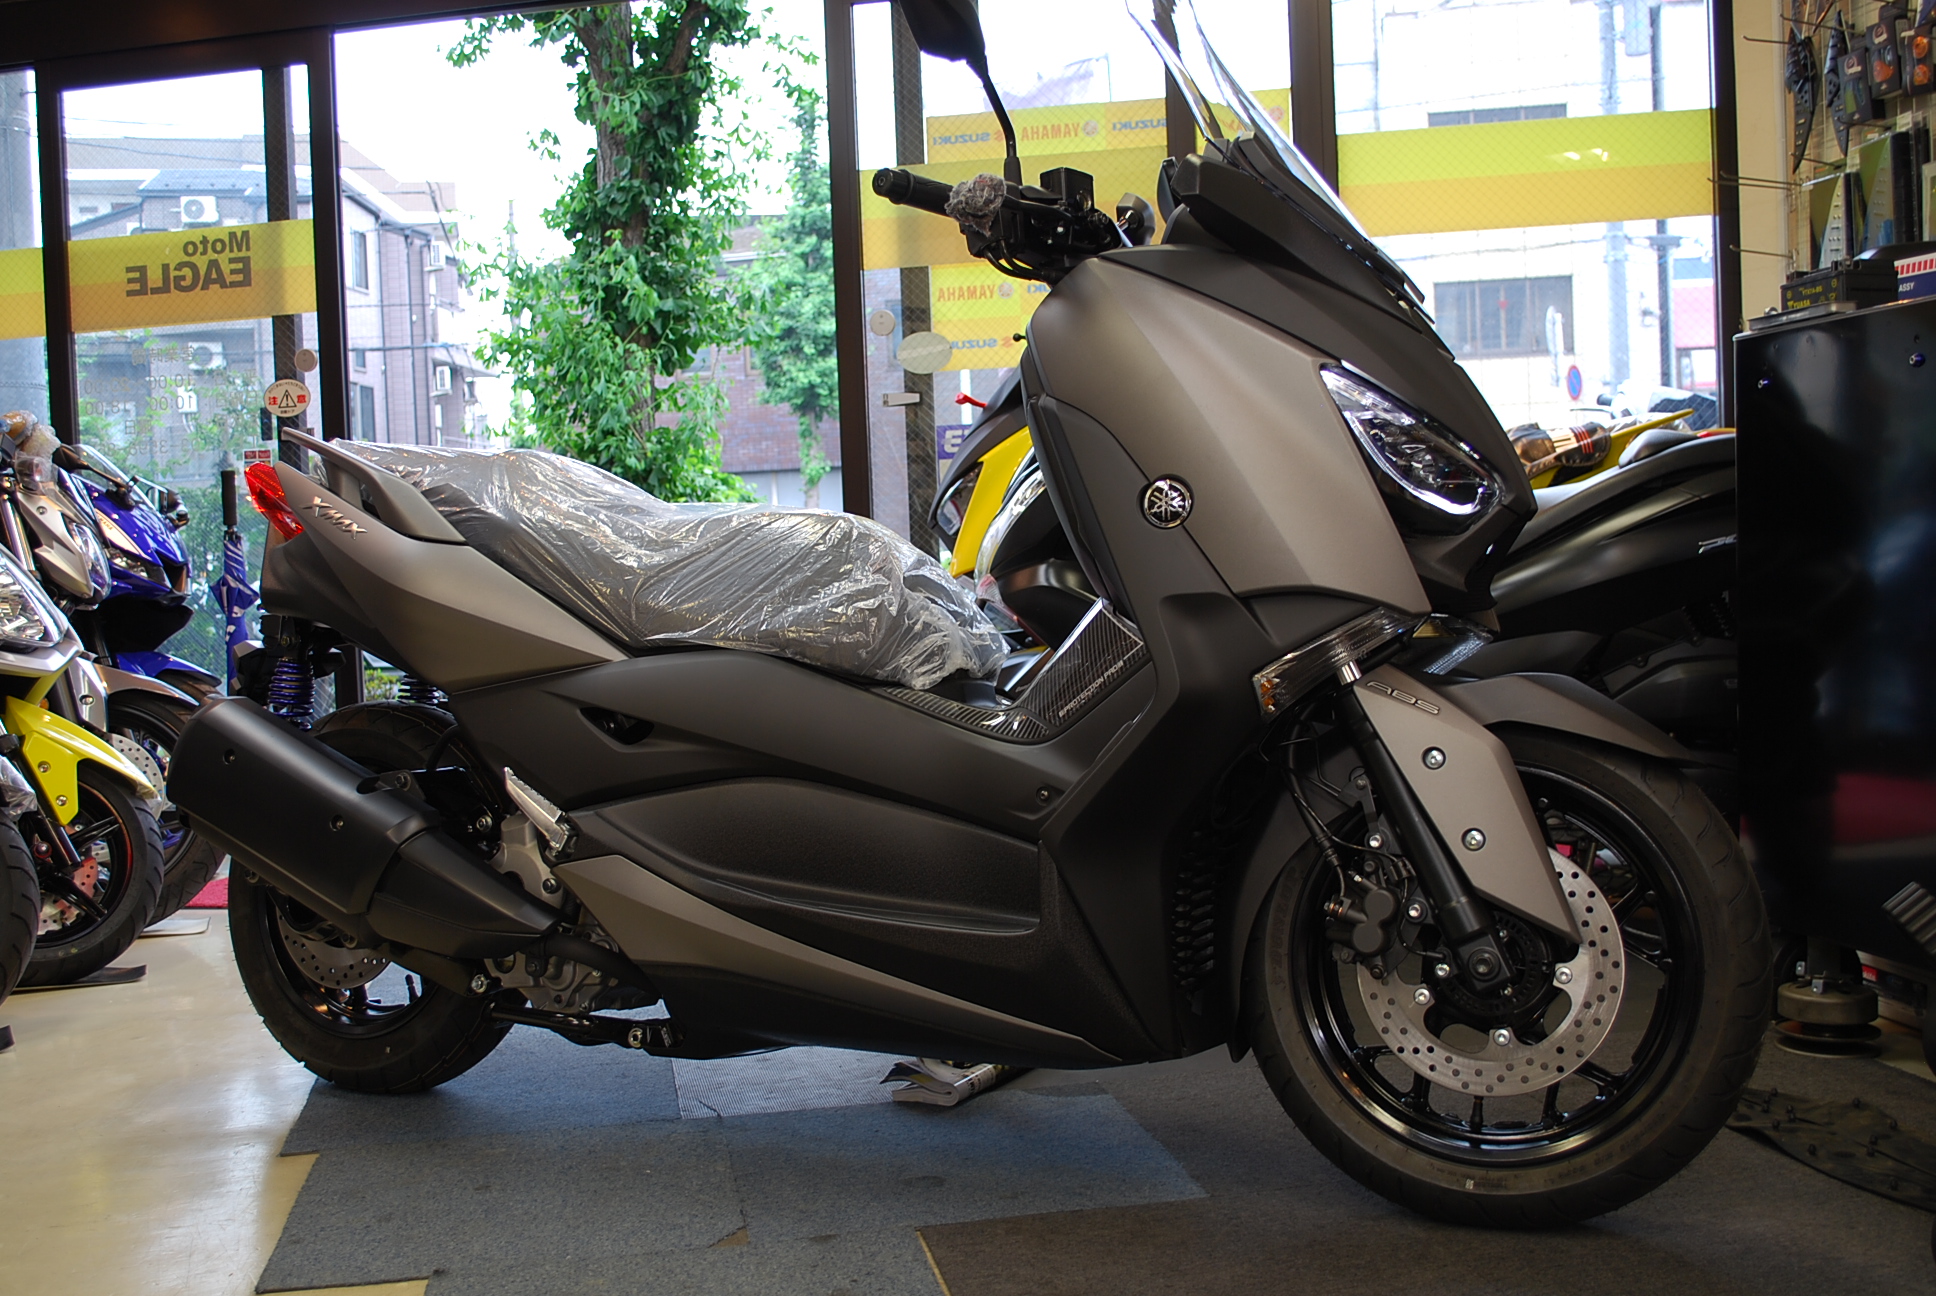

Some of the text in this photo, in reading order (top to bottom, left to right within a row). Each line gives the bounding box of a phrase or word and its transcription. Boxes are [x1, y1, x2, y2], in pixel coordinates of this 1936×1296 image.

[1899, 282, 1915, 292] ASSY
[301, 496, 368, 540] XMAX
[1367, 681, 1441, 714] ABS
